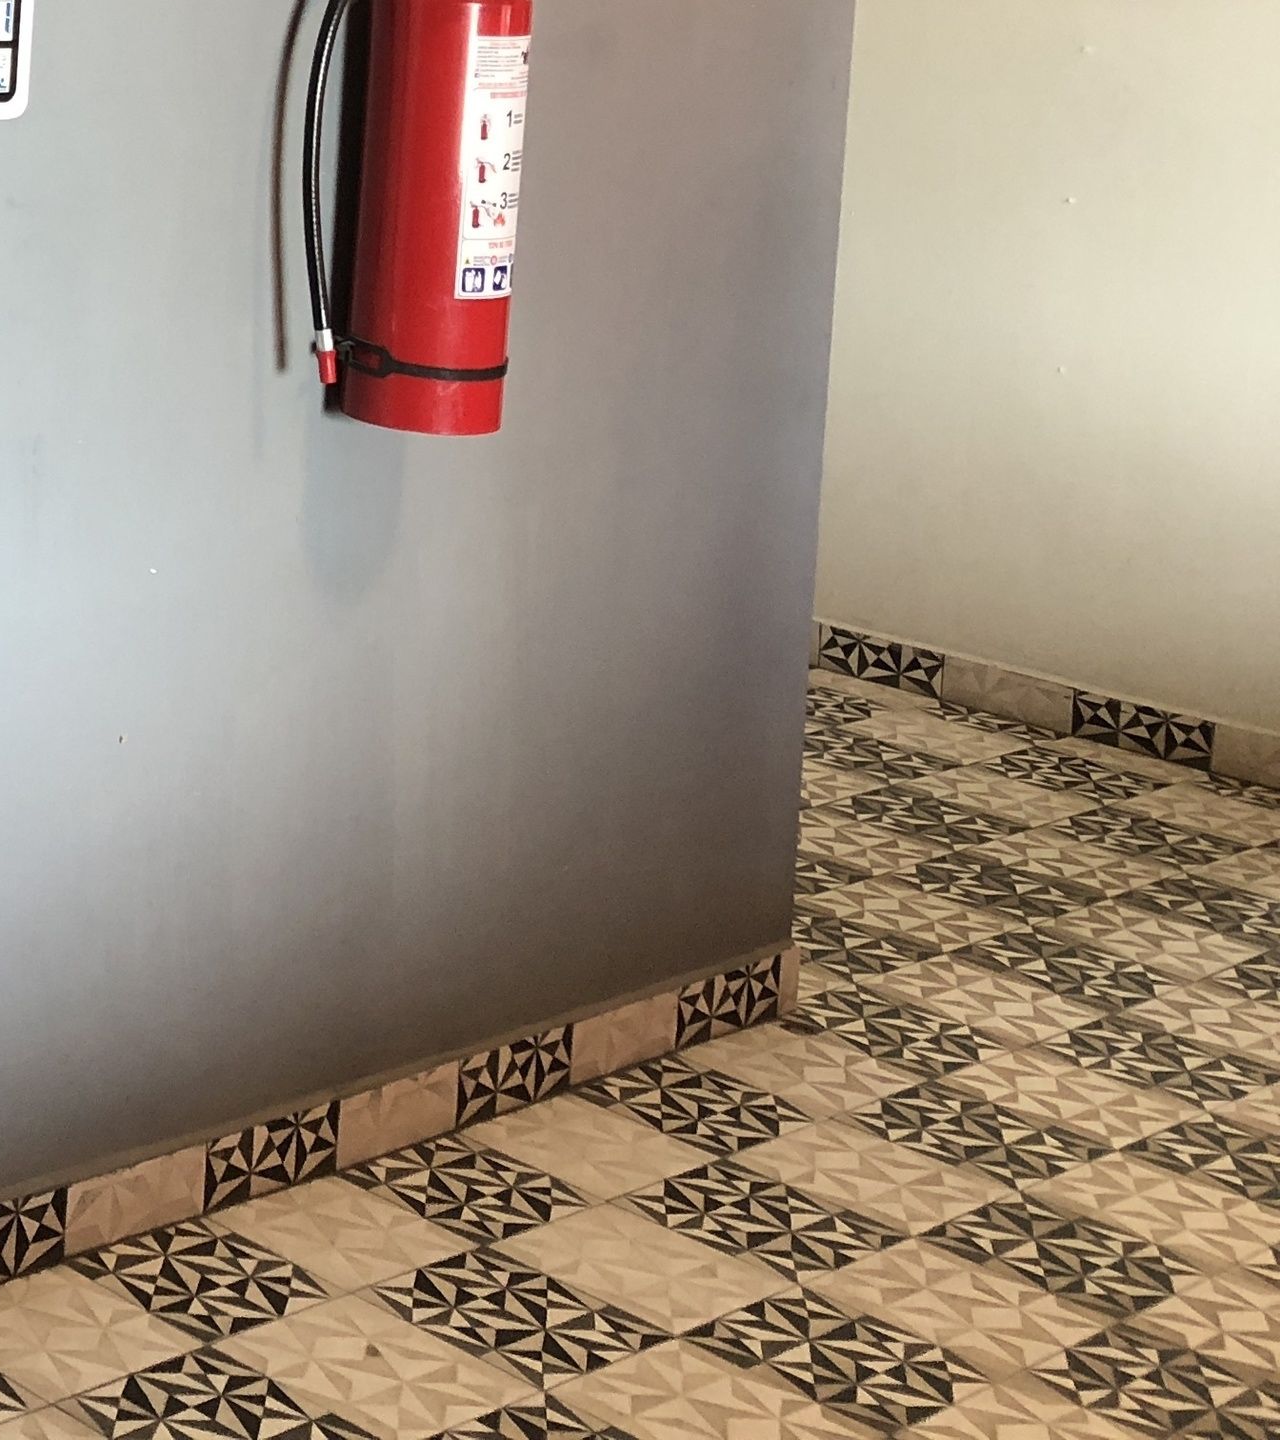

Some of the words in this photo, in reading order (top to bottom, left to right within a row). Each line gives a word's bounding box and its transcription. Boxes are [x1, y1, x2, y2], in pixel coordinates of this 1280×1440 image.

[506, 110, 513, 128] 1
[503, 153, 511, 171] 2
[500, 192, 508, 210] 3
